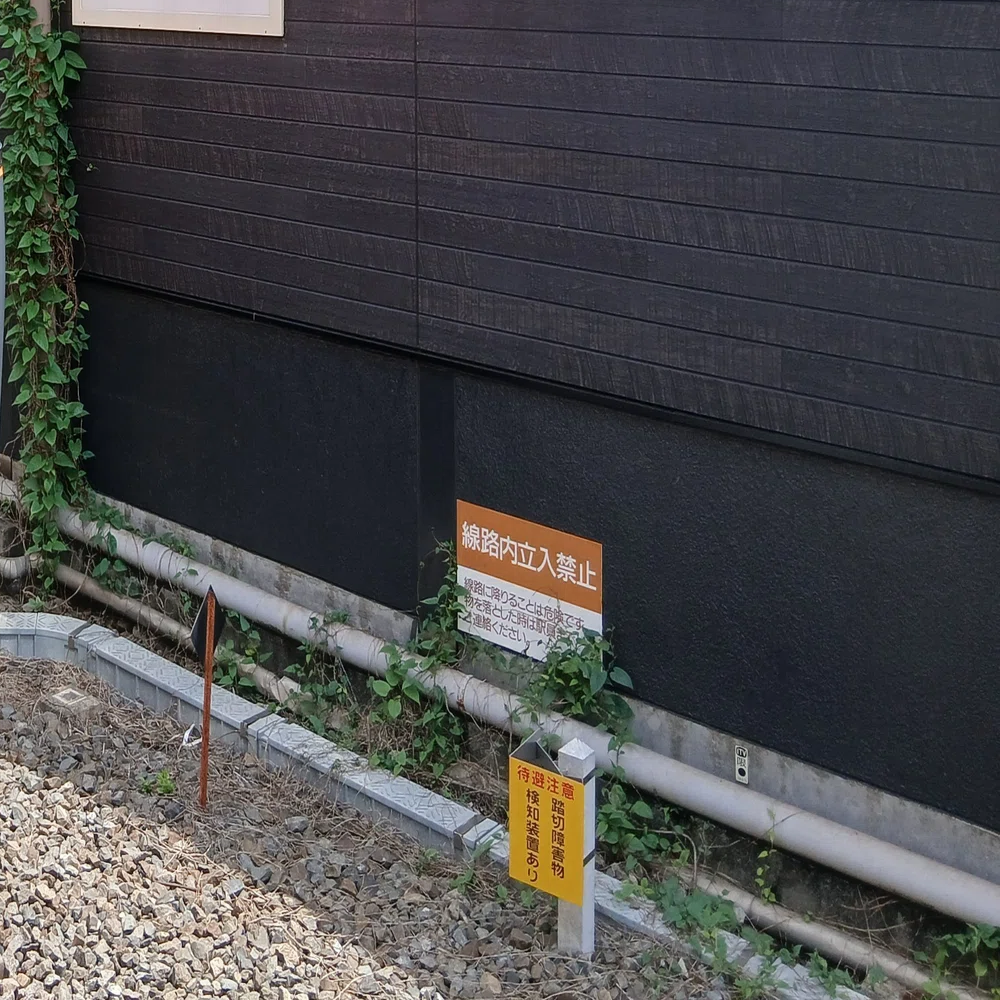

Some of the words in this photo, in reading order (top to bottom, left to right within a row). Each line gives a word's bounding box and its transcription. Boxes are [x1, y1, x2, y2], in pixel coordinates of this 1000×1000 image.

[462, 521, 597, 591] 線路内立入禁止
[517, 765, 575, 801] 待避注意
[525, 788, 540, 883] 検知装置あり
[551, 797, 565, 879] 踏切障害物
